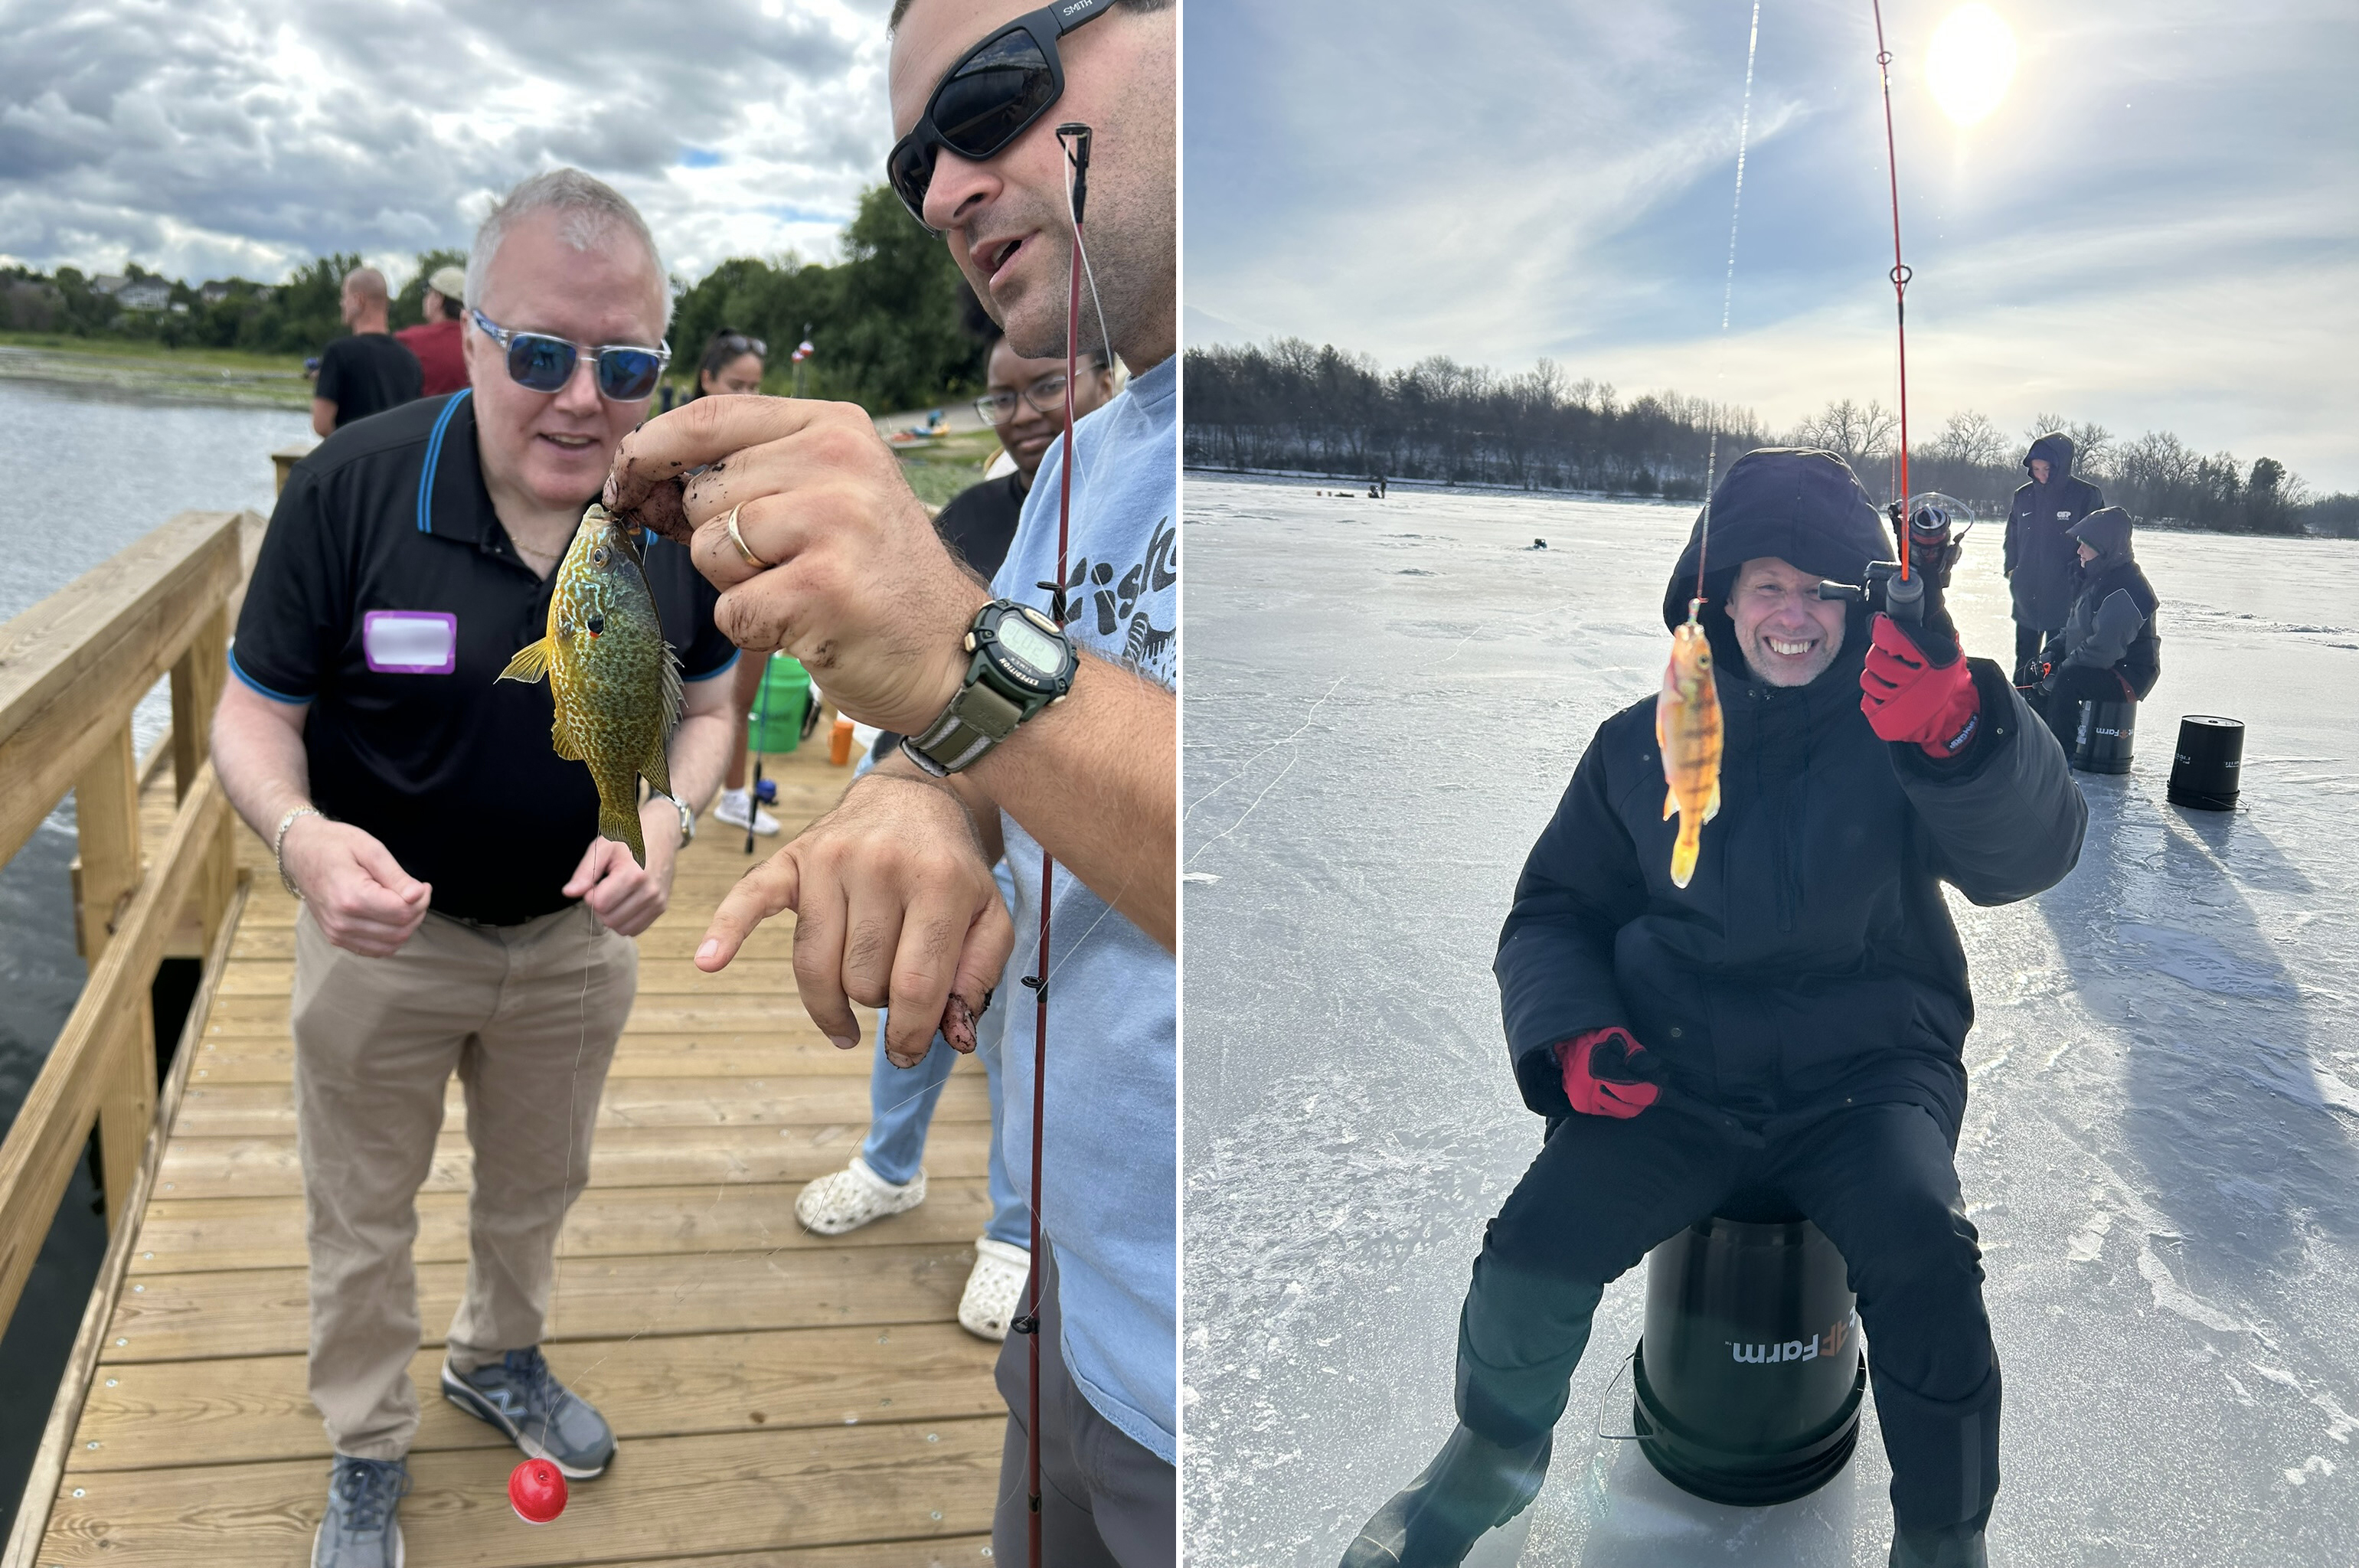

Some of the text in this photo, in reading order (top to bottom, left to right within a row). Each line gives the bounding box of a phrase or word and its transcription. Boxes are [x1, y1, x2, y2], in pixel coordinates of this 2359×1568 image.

[1063, 0, 1093, 16] SMITH
[998, 658, 1039, 687] EXPEDITION
[2096, 727, 2119, 737] Farm
[1949, 733, 1968, 749] GRIP
[1733, 1333, 1819, 1364] Farm
